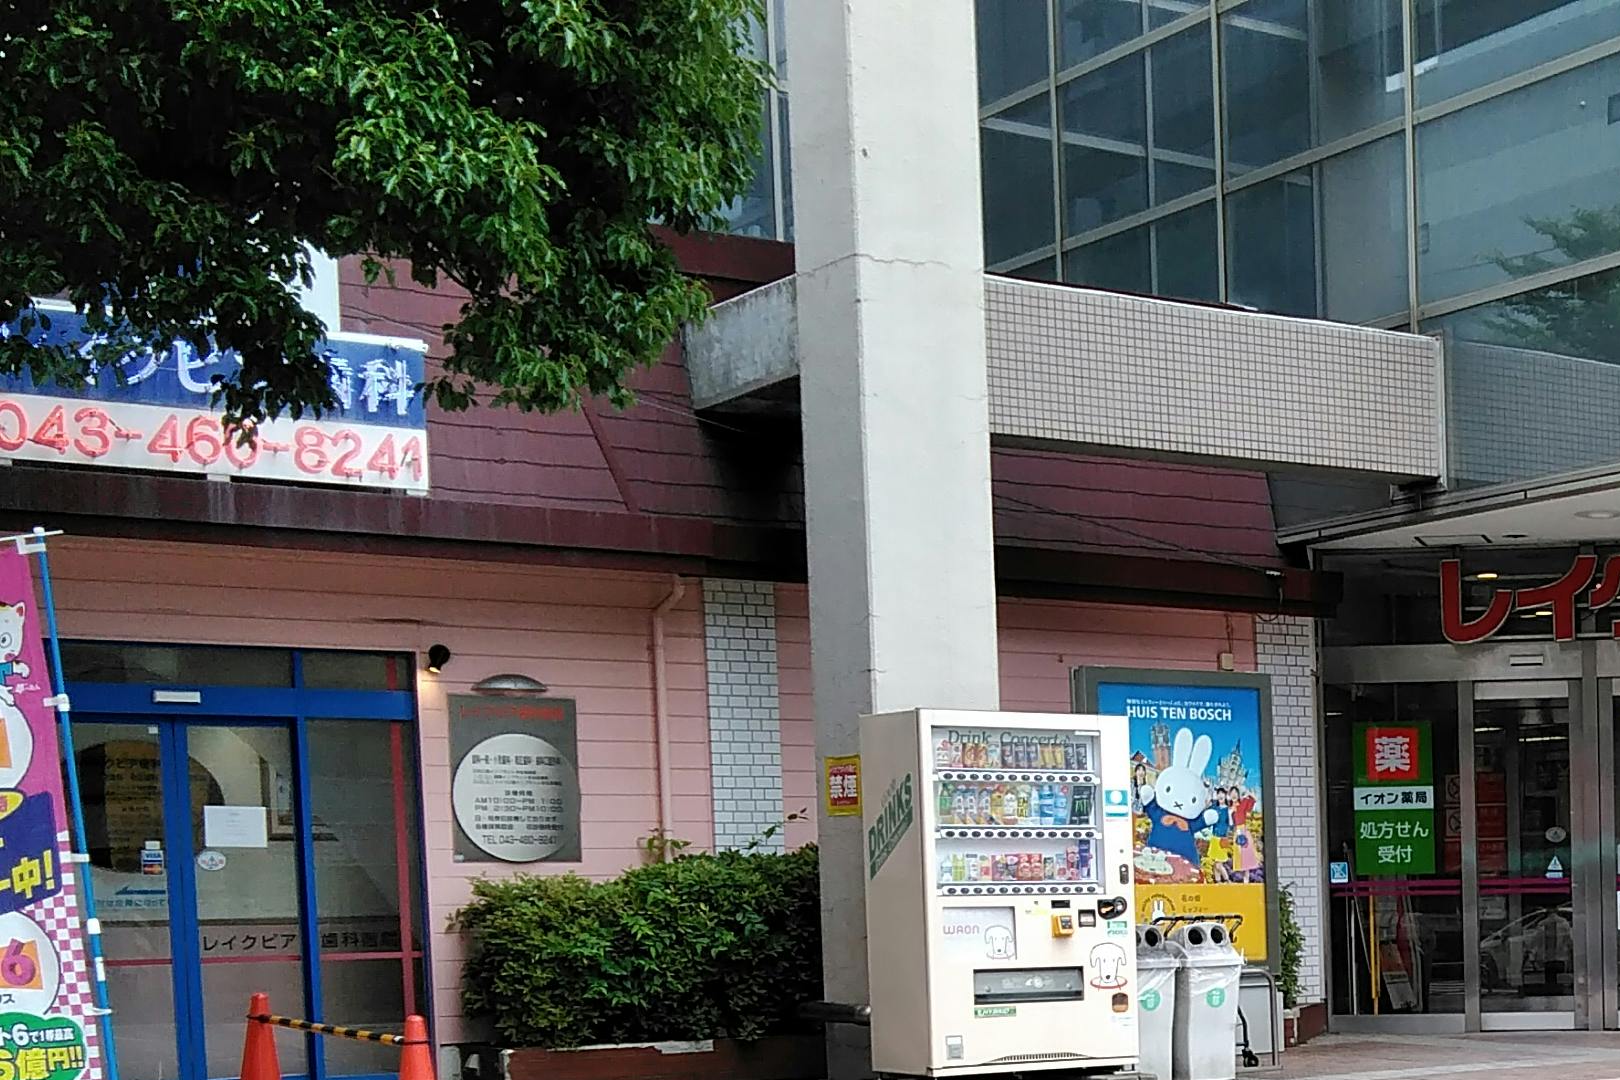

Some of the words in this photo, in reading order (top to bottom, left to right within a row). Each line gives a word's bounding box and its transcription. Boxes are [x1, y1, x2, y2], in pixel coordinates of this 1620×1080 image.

[0, 402, 423, 482] 043-460-8241
[1126, 705, 1158, 719] HUIS
[1160, 706, 1187, 720] TEN
[1189, 708, 1232, 722] BOSCH
[948, 730, 993, 744] Drink
[1374, 736, 1411, 772] 薬
[829, 774, 858, 799] 禁煙
[1360, 791, 1428, 805] イオン薬局
[868, 773, 912, 862] DRINKS
[1360, 820, 1429, 840] 処方せん
[1378, 844, 1413, 864] 受付
[943, 925, 980, 935] WAON
